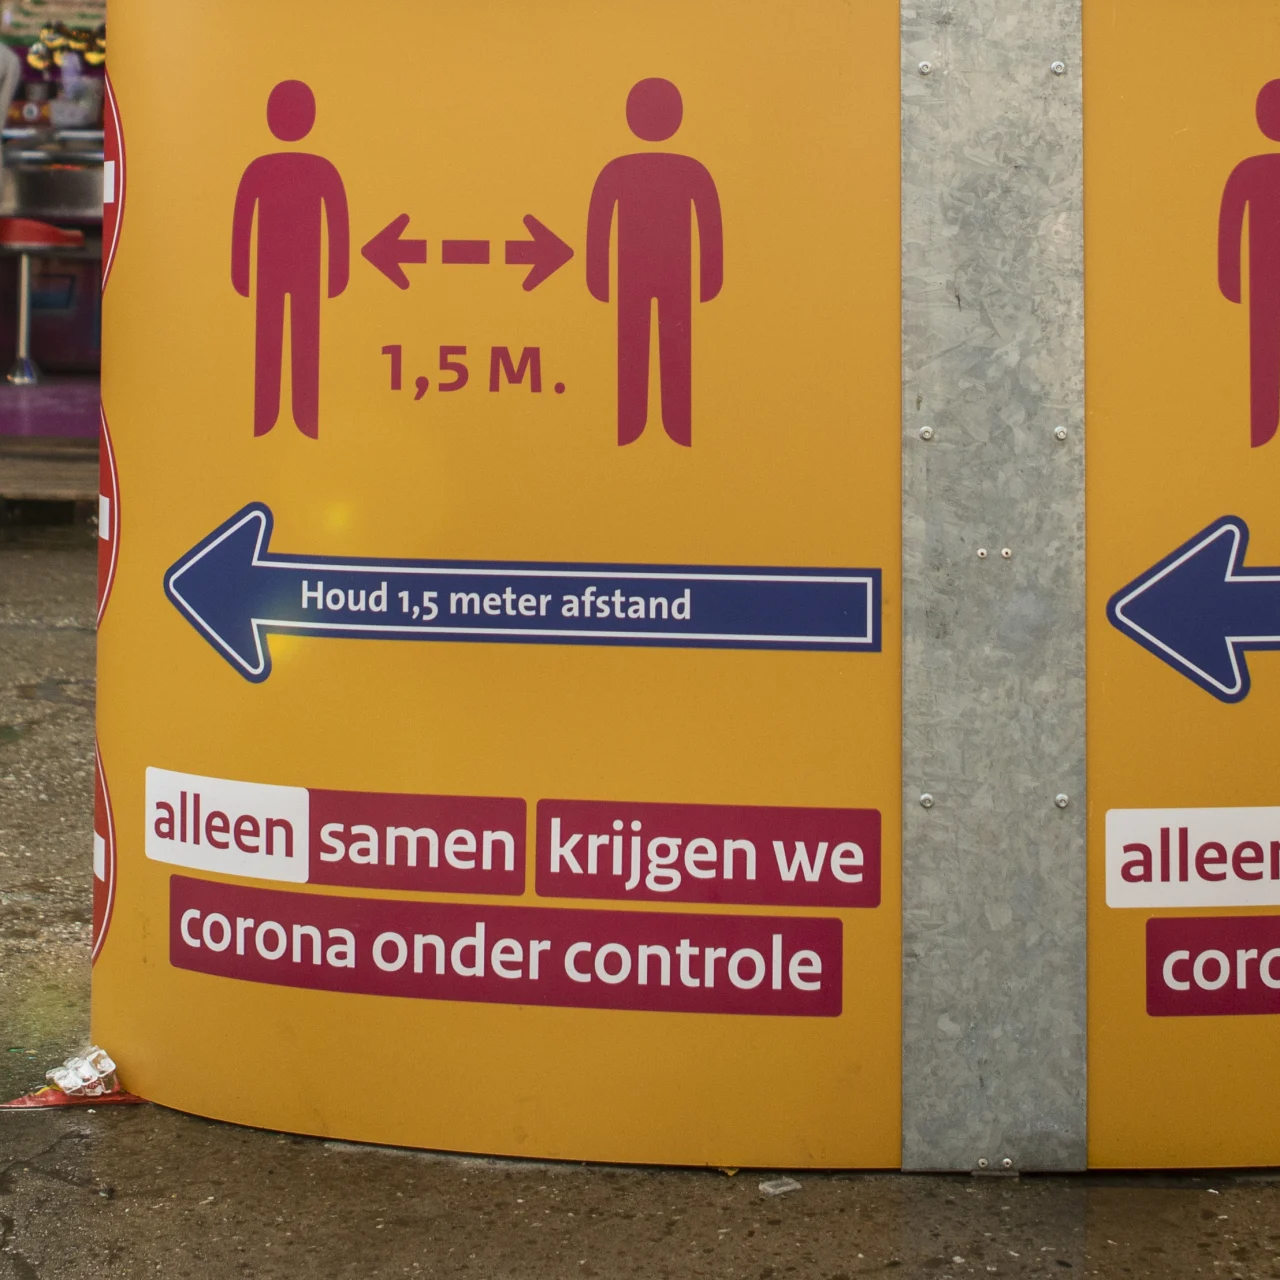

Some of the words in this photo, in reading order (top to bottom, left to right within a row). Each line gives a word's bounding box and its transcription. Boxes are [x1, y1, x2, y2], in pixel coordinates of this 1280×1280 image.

[380, 344, 469, 400] 1,5
[300, 581, 388, 614] Houd
[398, 588, 439, 620] 1,5
[449, 589, 552, 618] meter
[561, 587, 692, 620] afstand
[154, 790, 294, 859] alleen
[320, 820, 515, 872] samen
[550, 816, 757, 892] krijgen
[773, 841, 864, 885] we
[180, 907, 356, 969] corona
[372, 921, 550, 980] onder
[564, 934, 823, 992] controle
